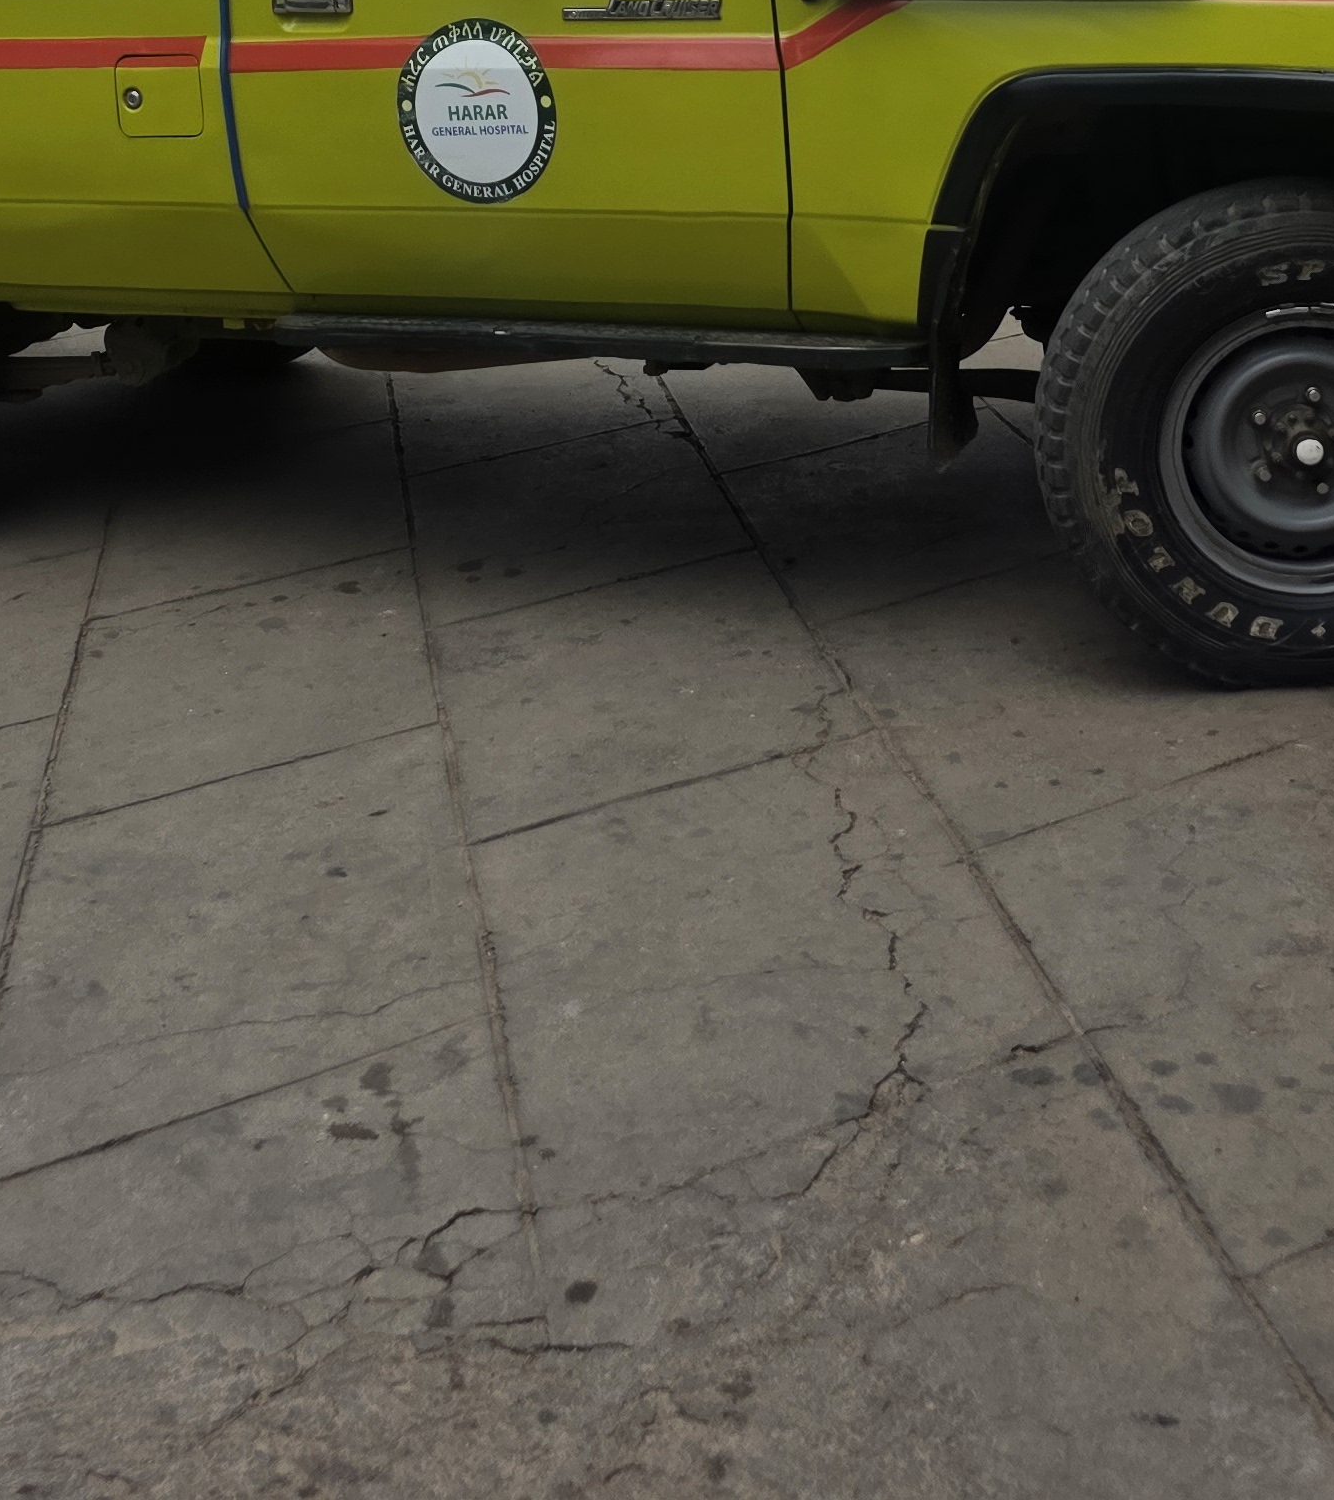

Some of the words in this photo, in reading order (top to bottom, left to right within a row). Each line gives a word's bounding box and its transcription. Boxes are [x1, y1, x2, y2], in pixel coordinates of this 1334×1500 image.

[447, 104, 508, 121] HARAR
[431, 125, 477, 136] GENERAL
[479, 124, 529, 136] HOSPITAL
[402, 123, 440, 178] HARAR
[442, 174, 513, 198] GENERAL
[512, 120, 556, 190] HOSPITAL
